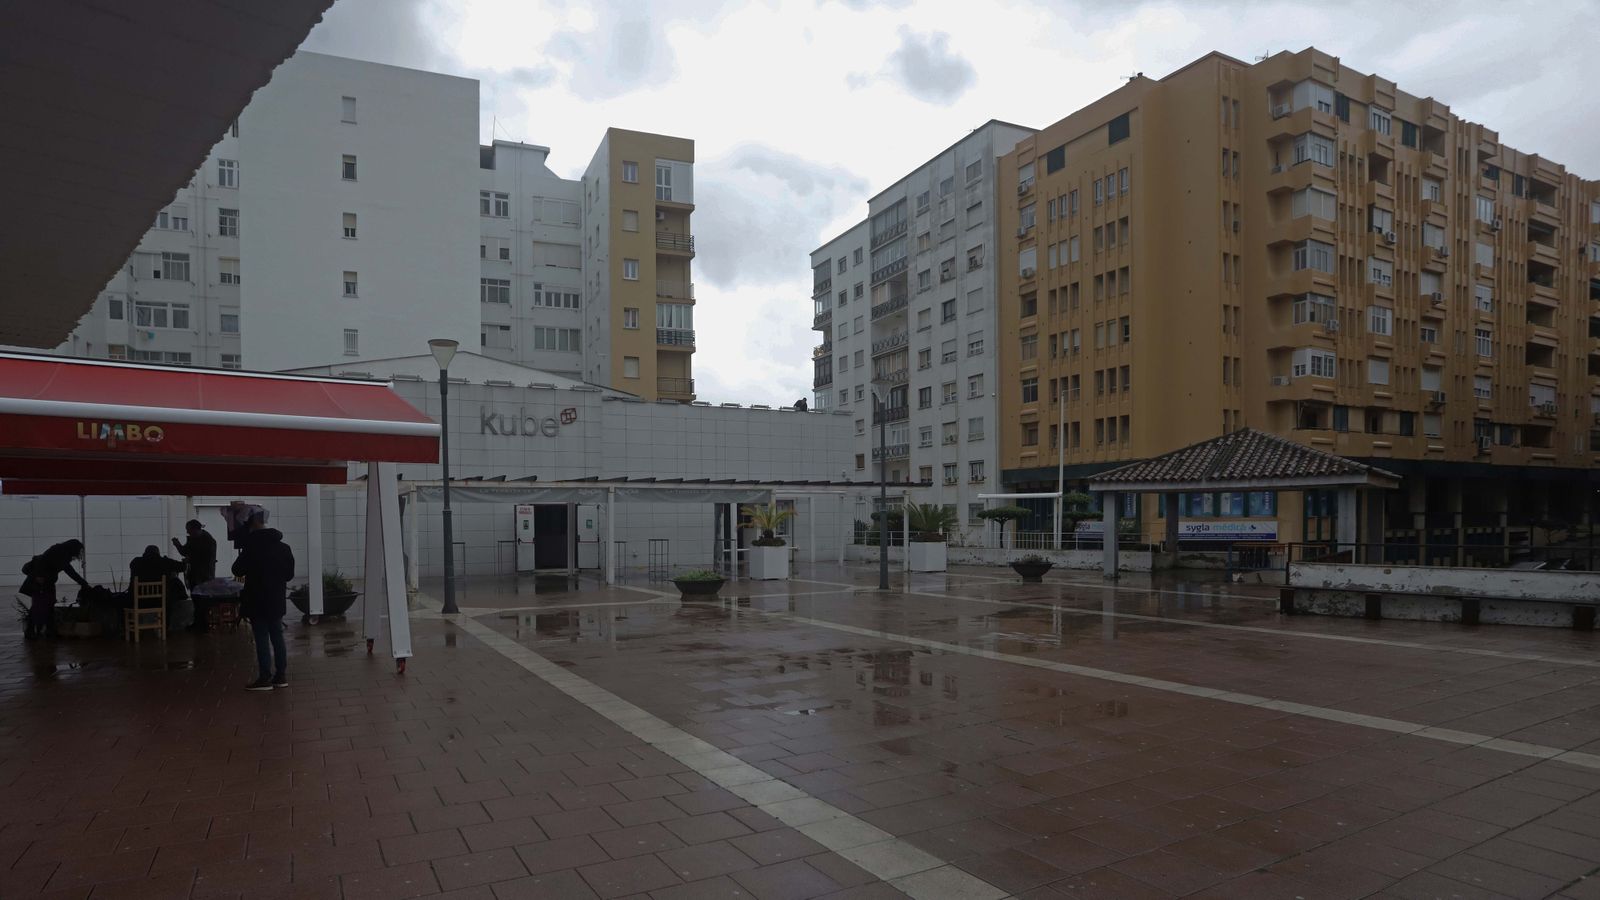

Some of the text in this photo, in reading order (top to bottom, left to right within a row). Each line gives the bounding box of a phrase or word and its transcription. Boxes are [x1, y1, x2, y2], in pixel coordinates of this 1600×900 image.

[480, 405, 560, 437] kube
[77, 422, 164, 443] LIMBO
[1185, 523, 1210, 533] sygla
